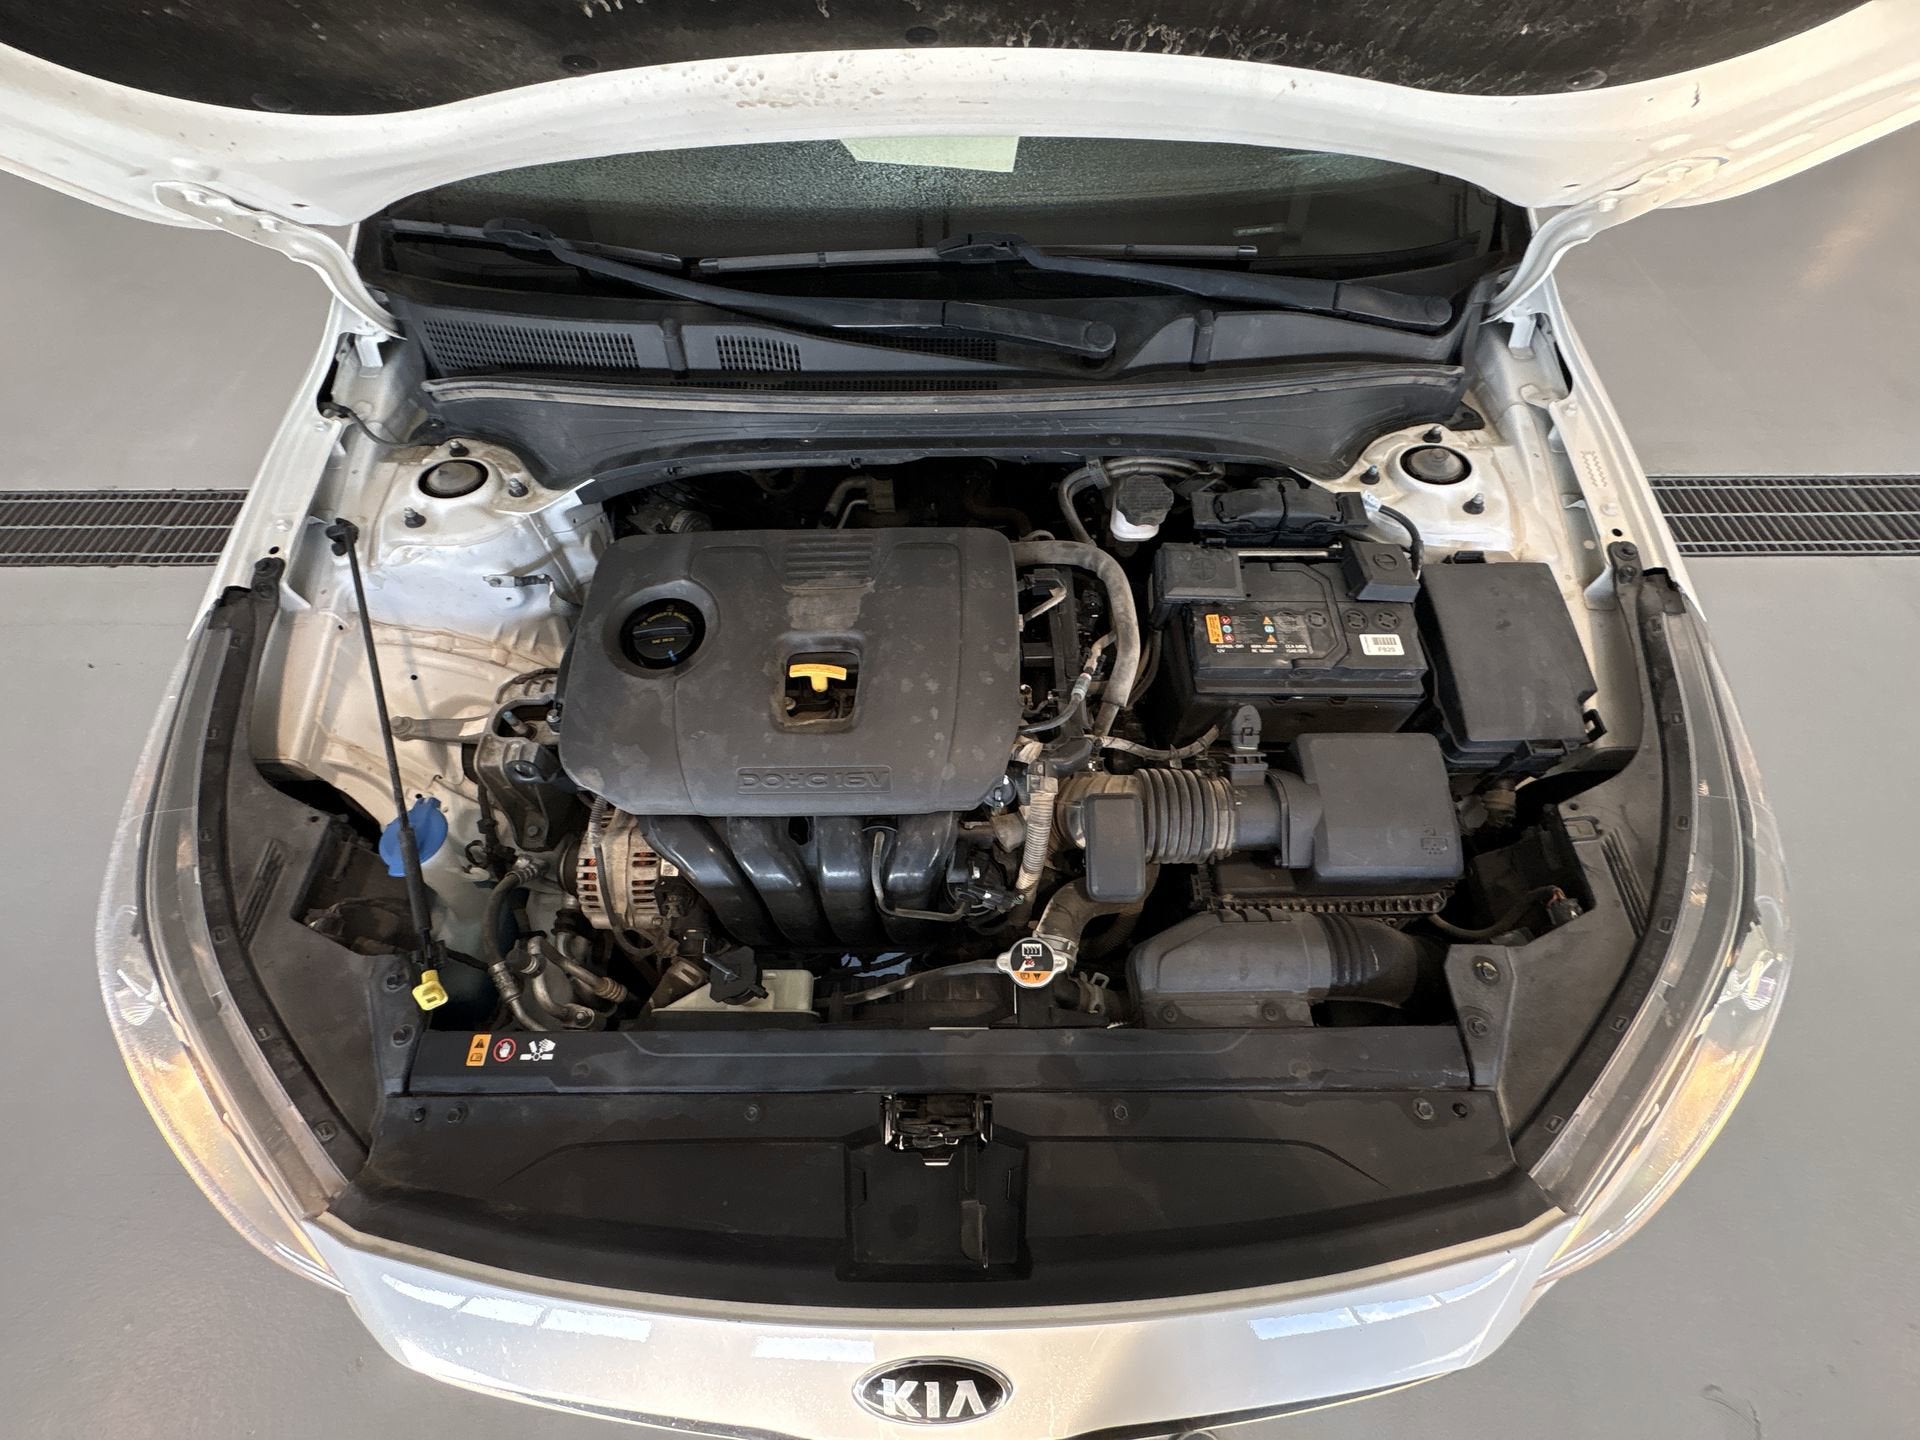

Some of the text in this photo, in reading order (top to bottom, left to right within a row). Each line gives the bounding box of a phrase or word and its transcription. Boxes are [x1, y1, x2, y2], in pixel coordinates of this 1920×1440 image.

[738, 771, 890, 789] DOHC 16V
[881, 1378, 987, 1418] KIA
